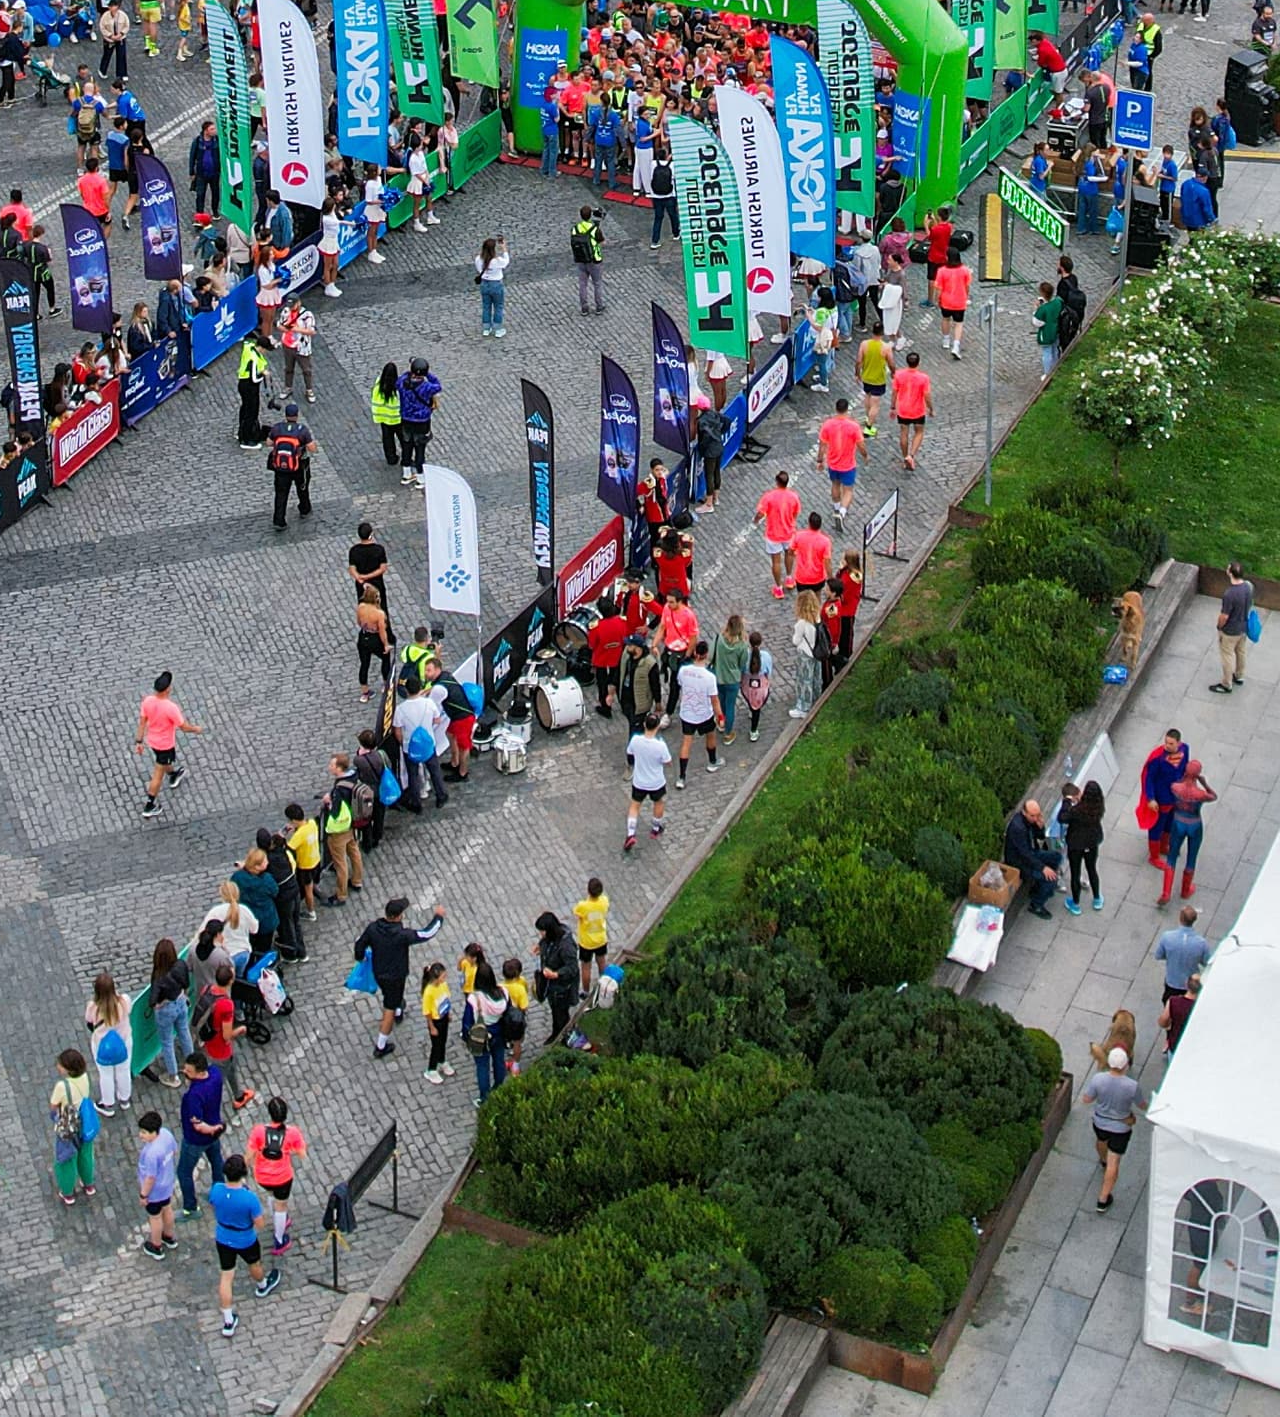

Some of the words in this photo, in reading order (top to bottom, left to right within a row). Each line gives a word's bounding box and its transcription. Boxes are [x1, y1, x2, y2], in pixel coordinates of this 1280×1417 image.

[525, 41, 561, 56] HOKA
[894, 102, 920, 122] HOKA
[1126, 100, 1142, 119] P
[761, 363, 785, 393] TURKISH
[761, 372, 785, 403] AIRLINES
[60, 425, 89, 463] World
[87, 405, 112, 441] Class
[17, 472, 38, 501] PEAK
[566, 565, 592, 604] World
[592, 545, 616, 577] Class
[526, 622, 544, 653] PEAK
[493, 654, 511, 683] PEAK
